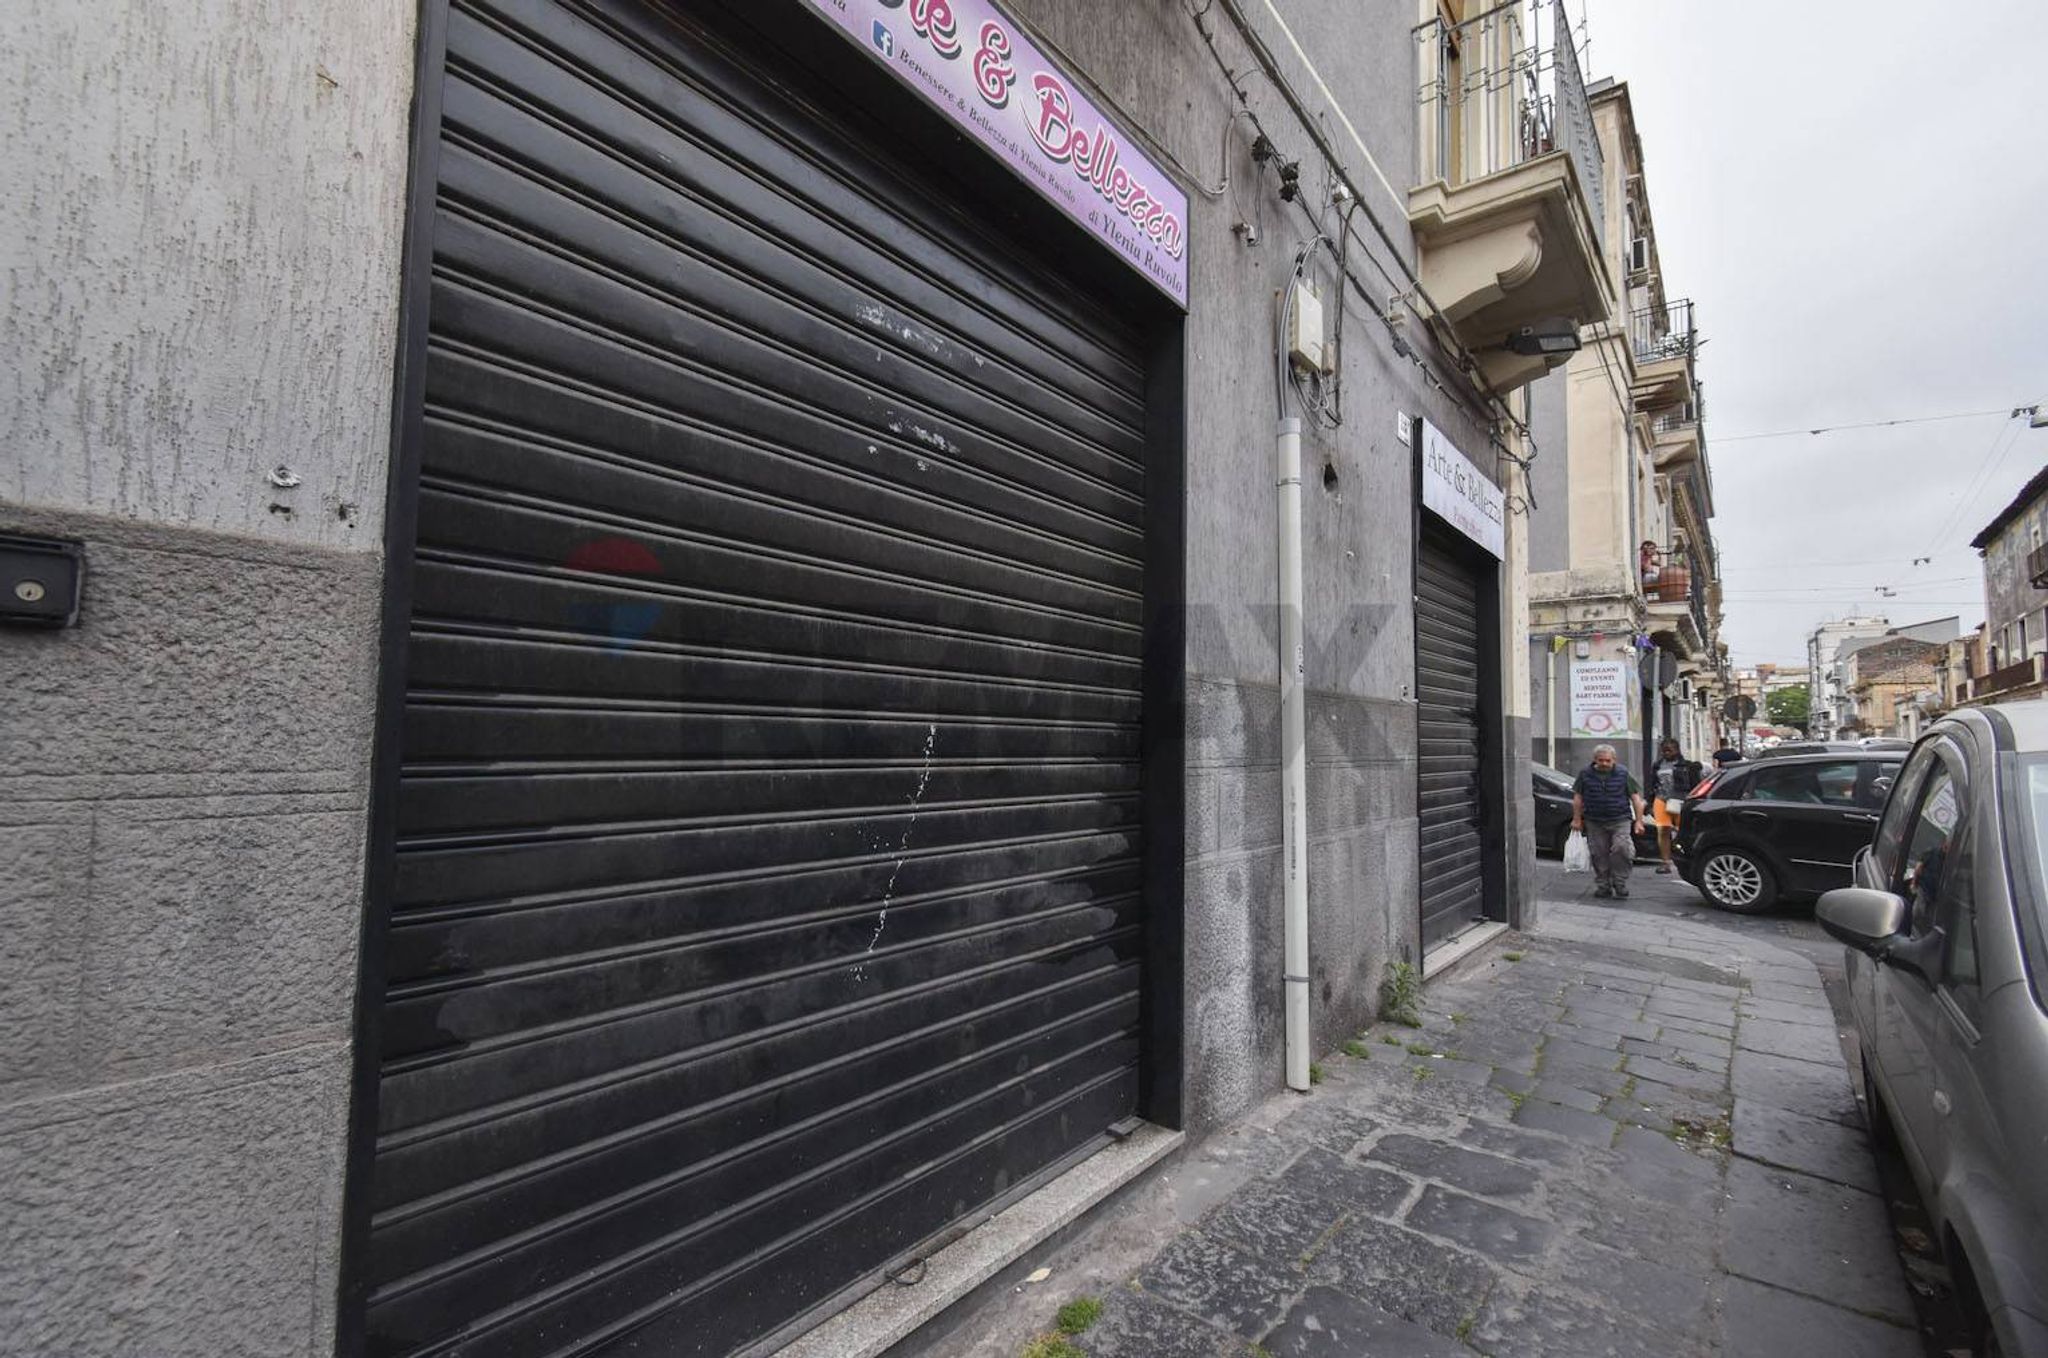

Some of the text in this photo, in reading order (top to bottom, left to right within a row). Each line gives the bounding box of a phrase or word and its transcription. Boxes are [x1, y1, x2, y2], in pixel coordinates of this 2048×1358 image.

[900, 49, 1075, 203] Benessere & Bellezza di Ylenia Ruvolo
[1019, 72, 1183, 260] Bellezza
[1088, 210, 1182, 293] di Ylenia Ruvolo
[1428, 438, 1453, 486] Arte
[1454, 462, 1466, 497] &
